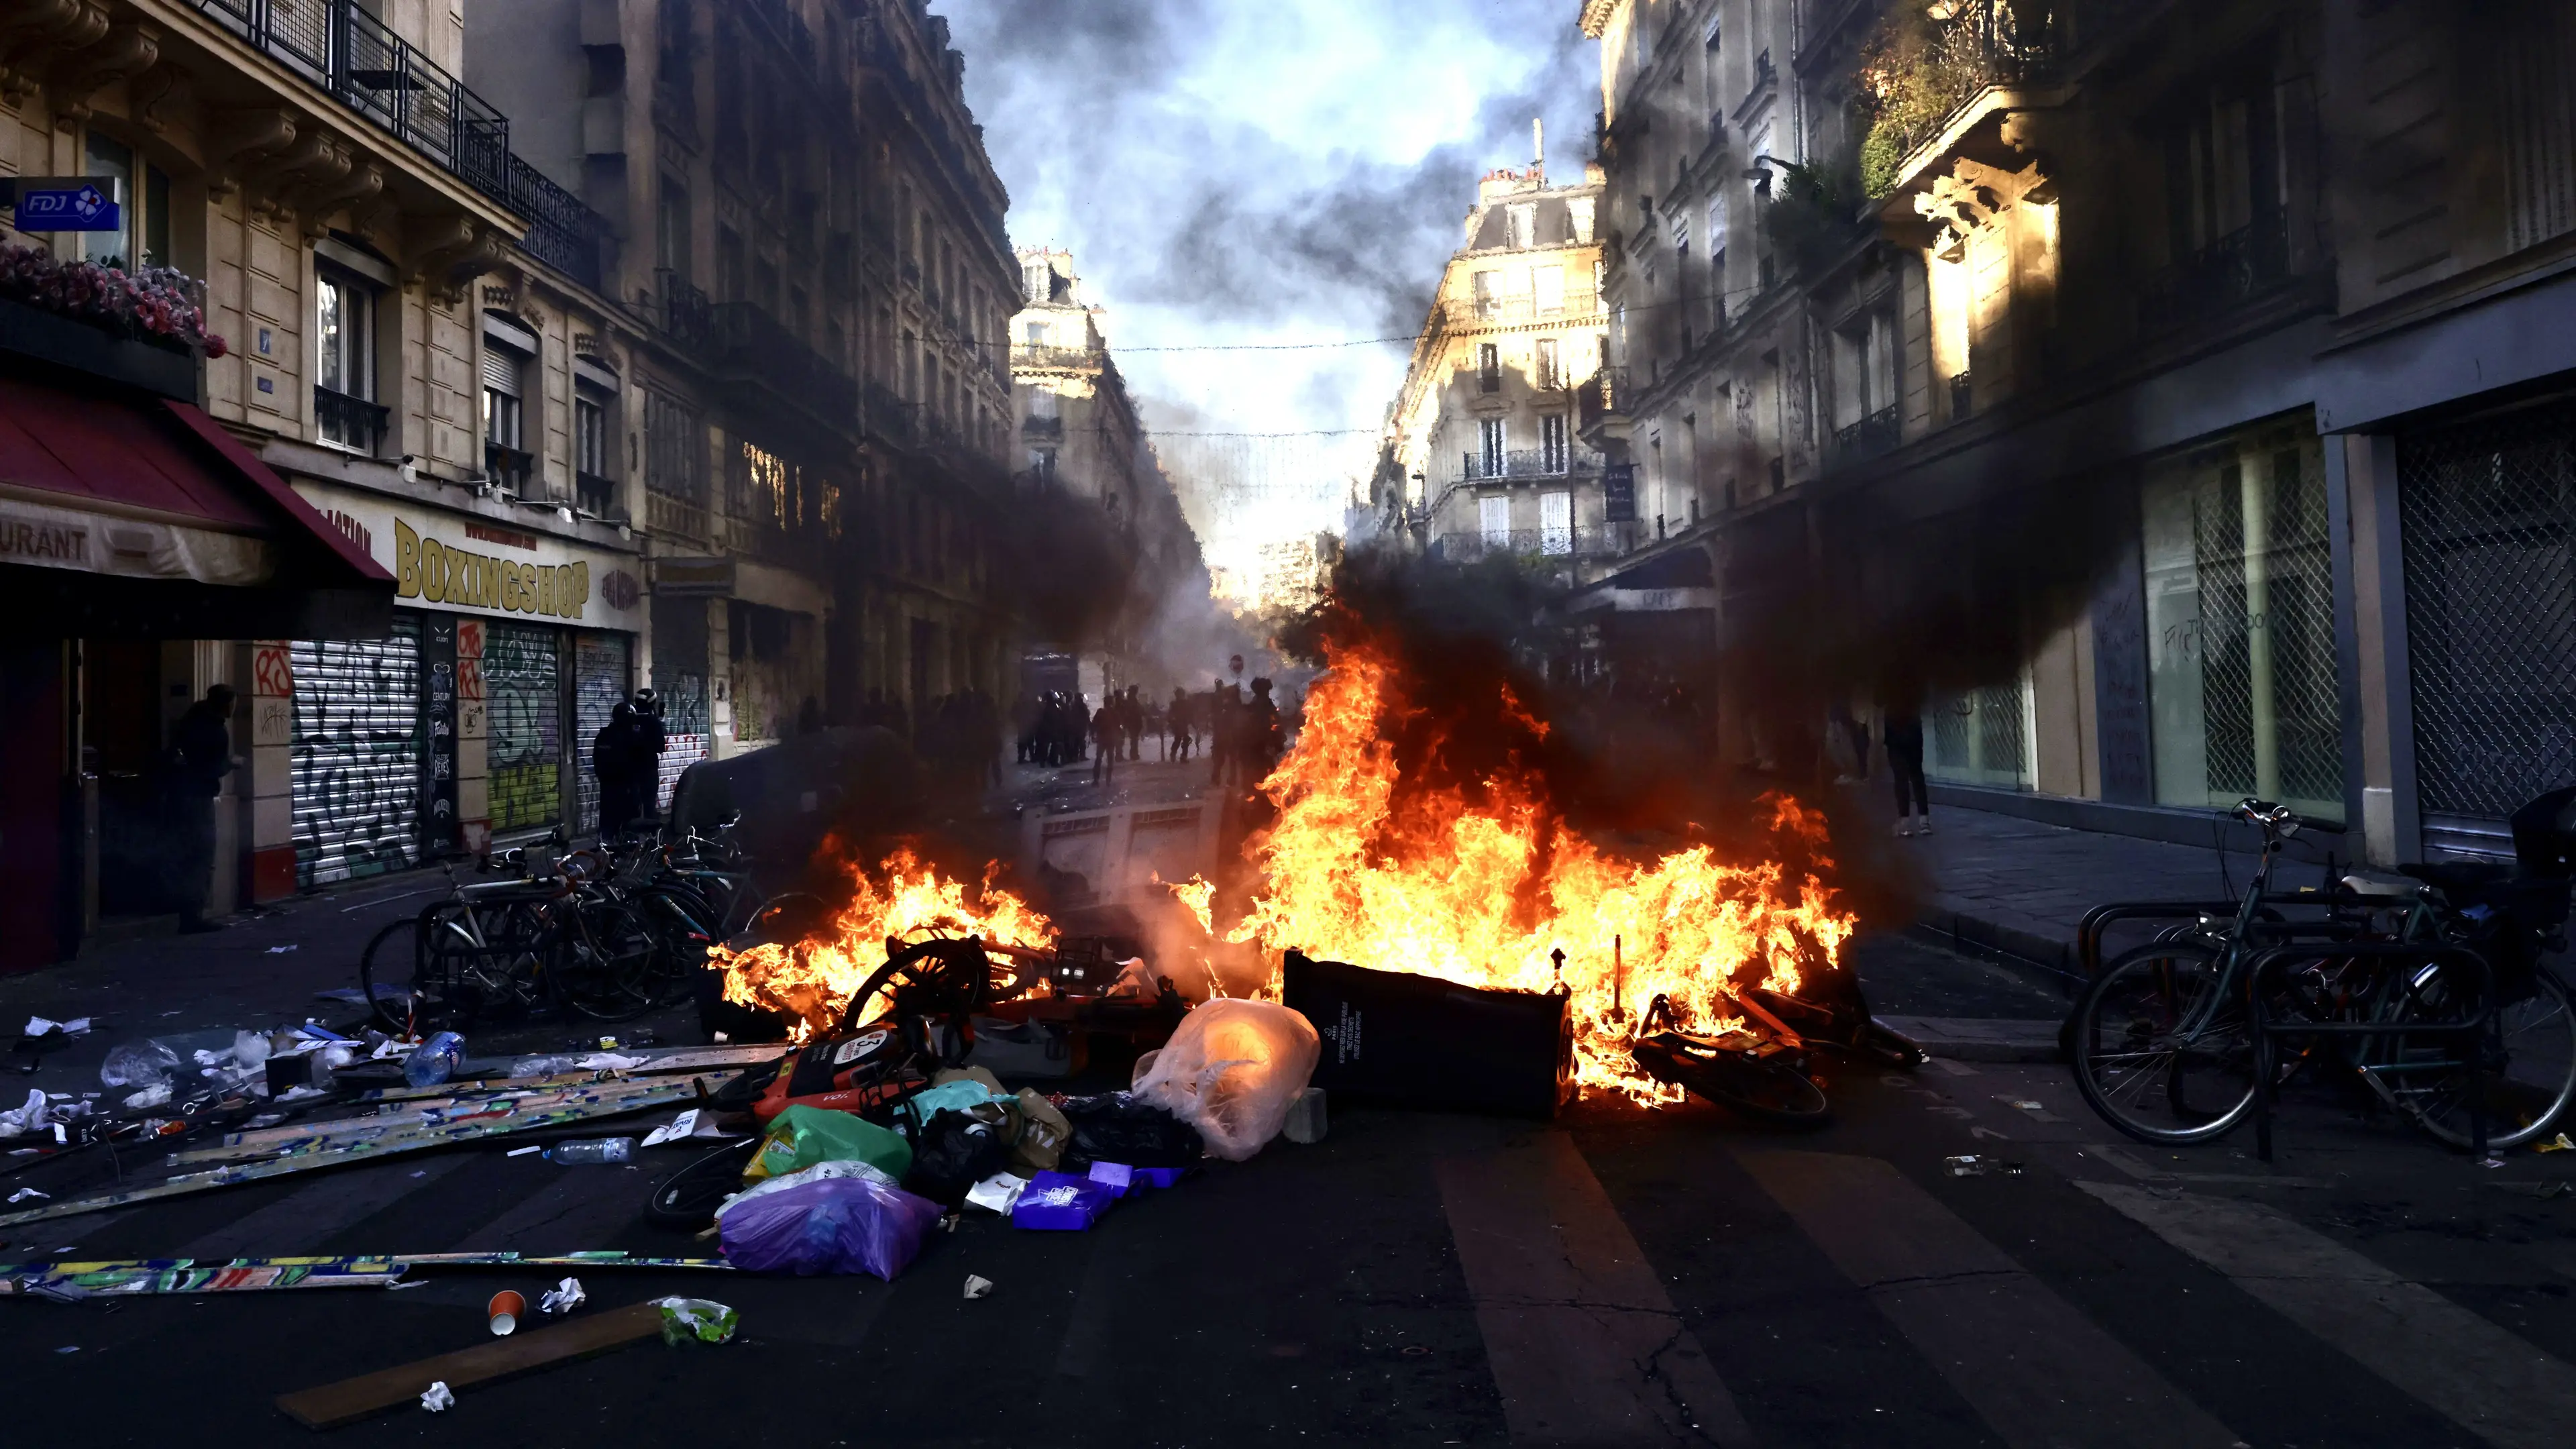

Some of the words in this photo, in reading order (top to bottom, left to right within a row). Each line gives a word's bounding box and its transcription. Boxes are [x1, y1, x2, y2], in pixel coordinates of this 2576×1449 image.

[28, 195, 68, 211] FDJ
[394, 516, 589, 620] BOXINGSHOP
[433, 692, 450, 701] CENTURY
[435, 759, 449, 777] REYES
